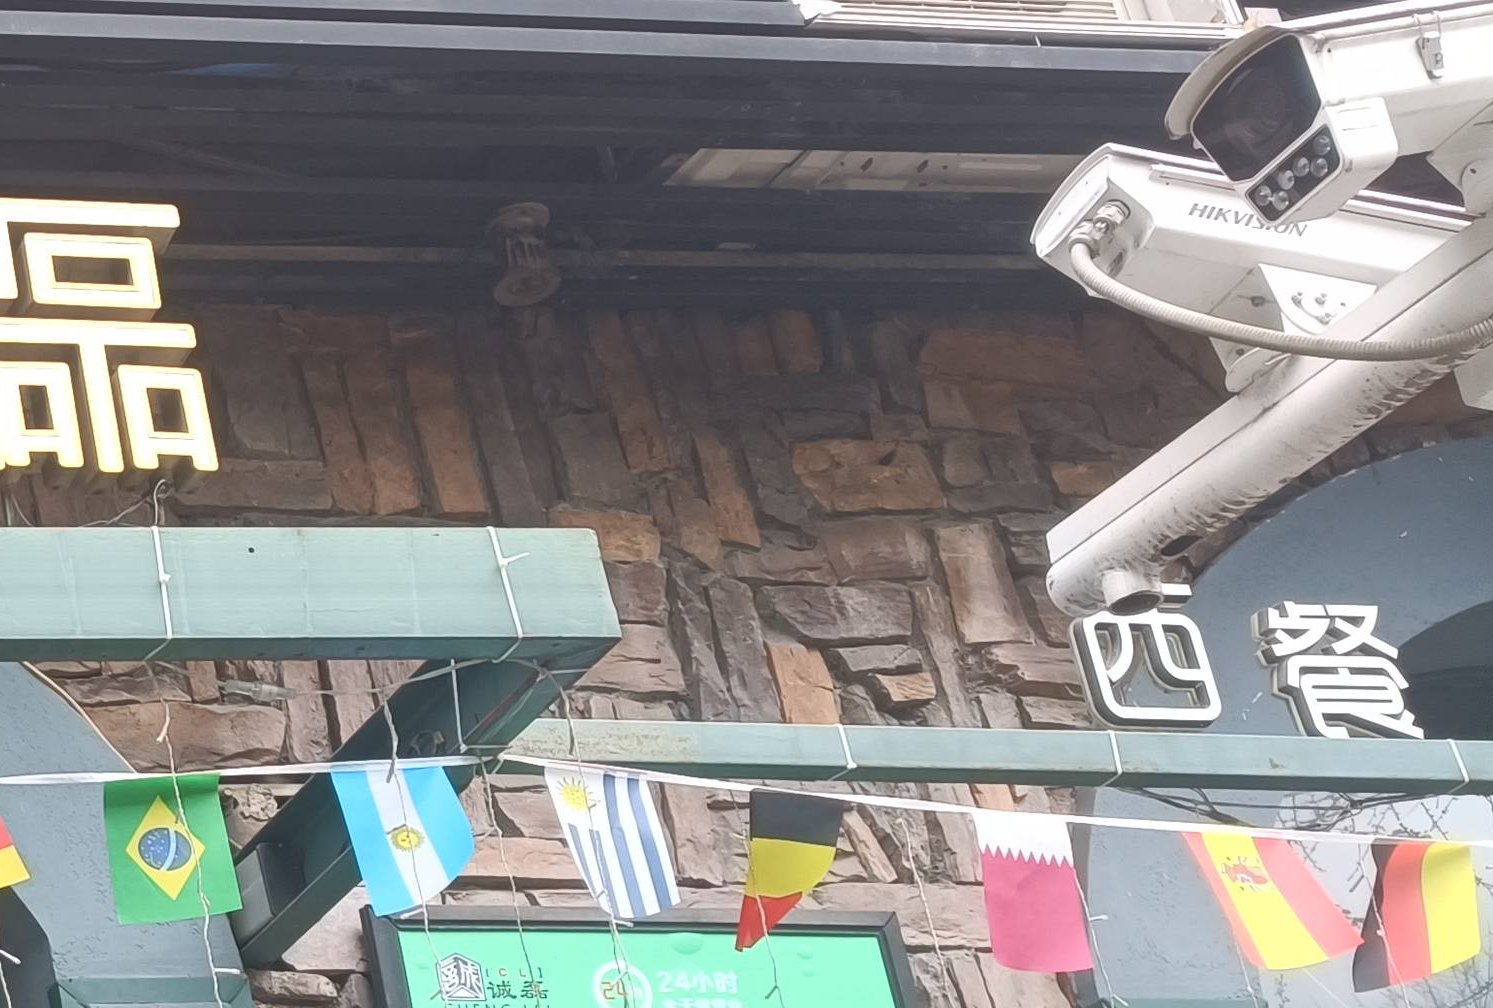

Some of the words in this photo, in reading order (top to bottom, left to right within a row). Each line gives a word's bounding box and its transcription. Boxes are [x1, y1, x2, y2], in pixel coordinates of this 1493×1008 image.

[1189, 203, 1307, 237] HIKVISON
[486, 980, 549, 1000] 诚磊
[657, 970, 740, 994] 24小时
